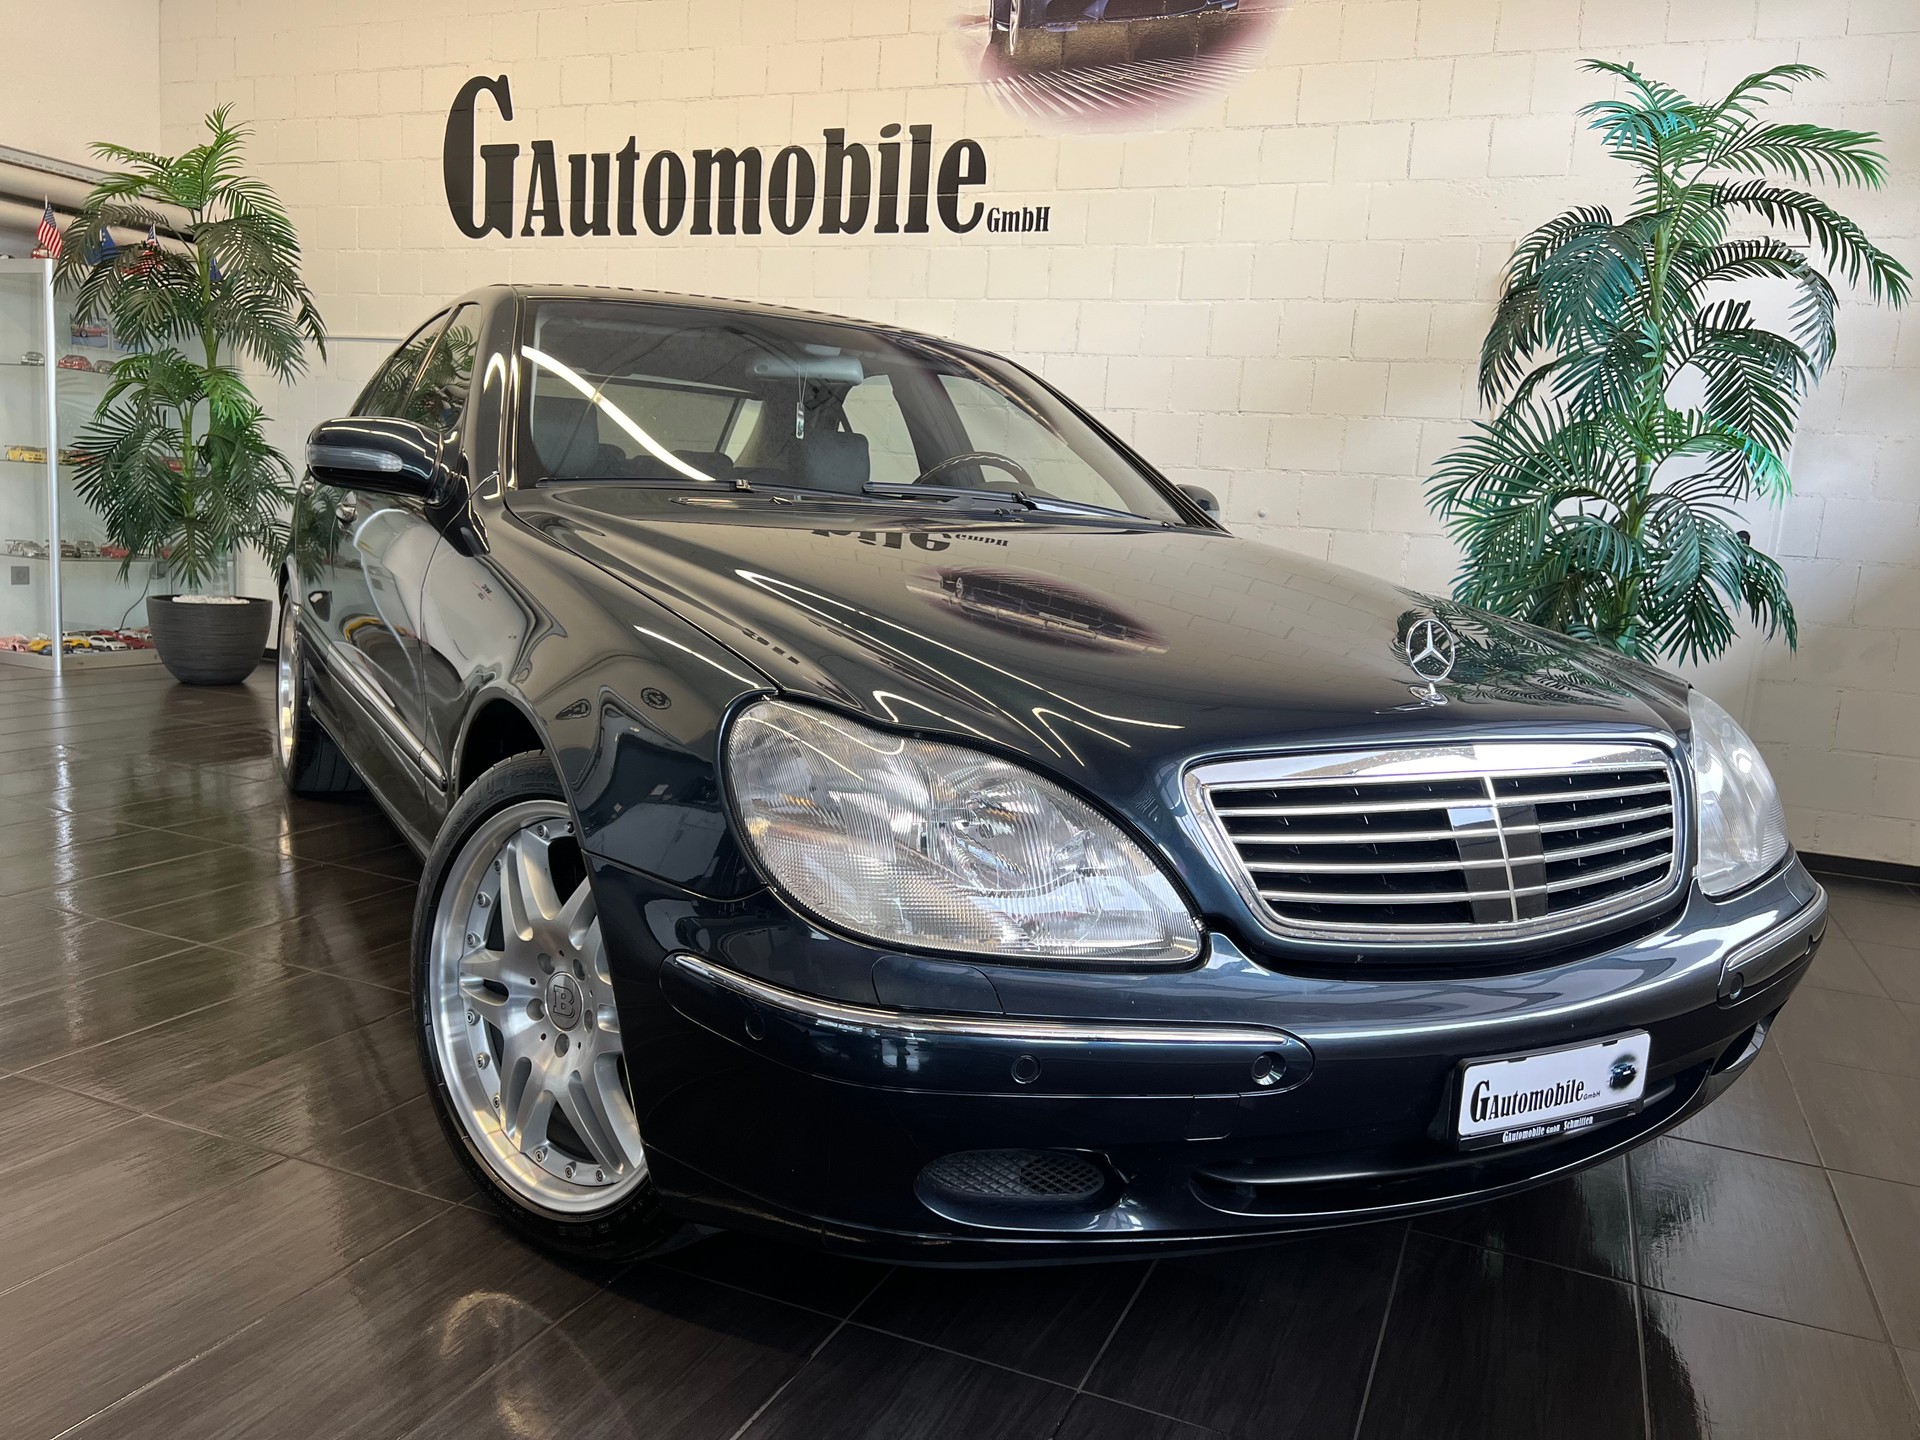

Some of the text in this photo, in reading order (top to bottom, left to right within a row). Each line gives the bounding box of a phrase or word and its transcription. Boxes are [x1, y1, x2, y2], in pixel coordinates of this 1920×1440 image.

[443, 74, 1051, 239] GAutomobile GmbH
[552, 984, 576, 1018] B
[1469, 1078, 1584, 1123] GAutomobile
